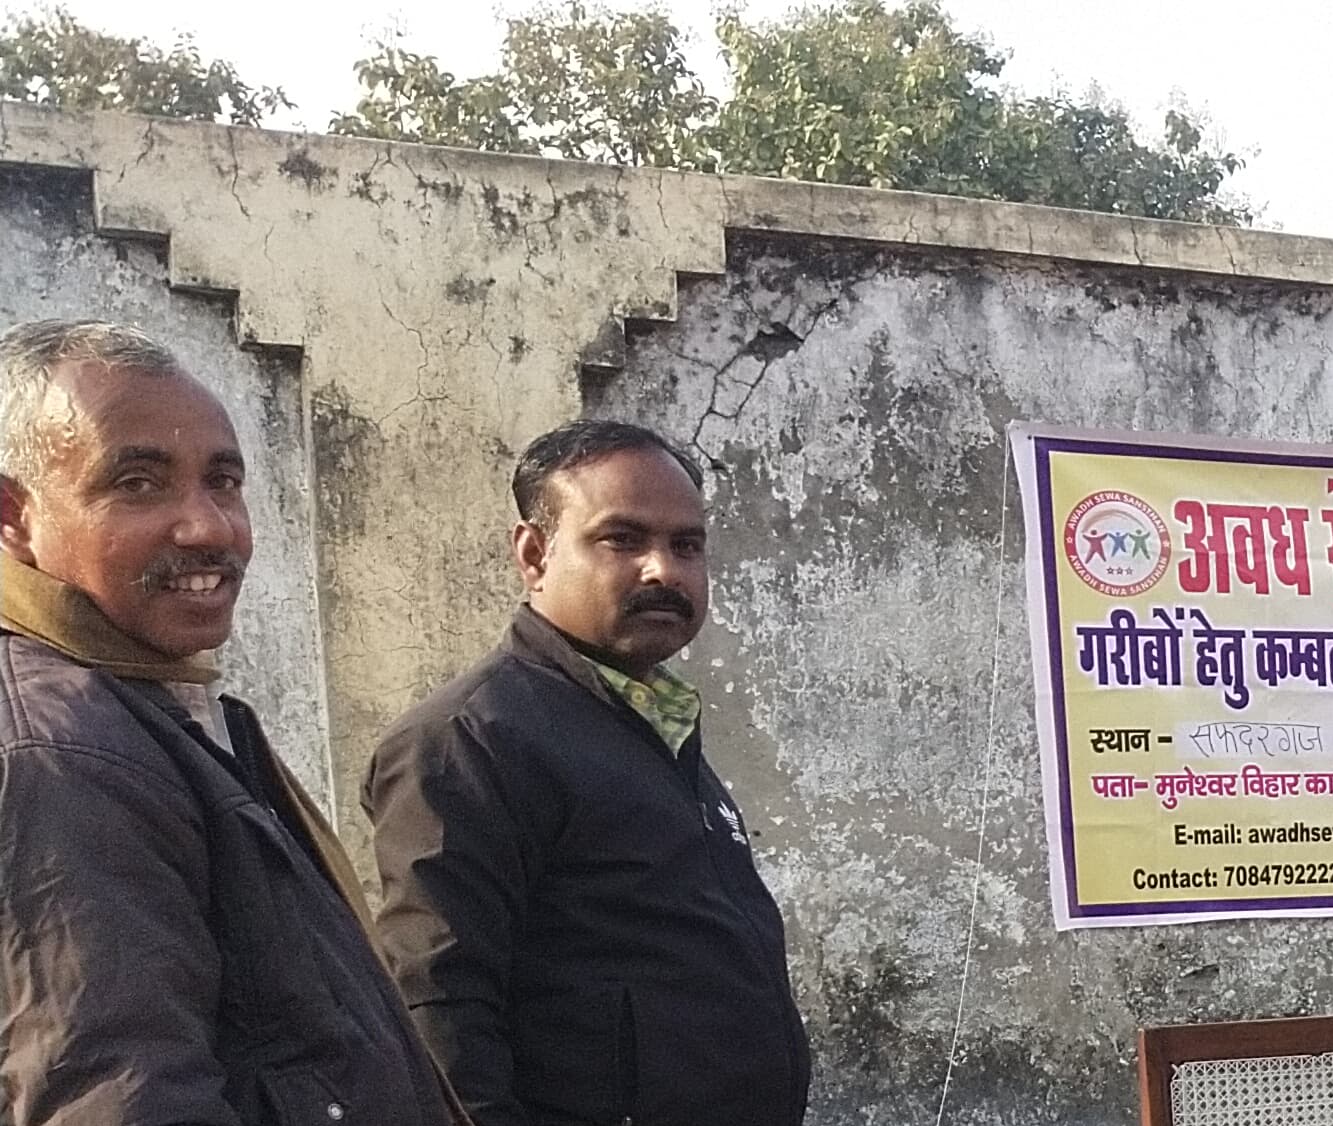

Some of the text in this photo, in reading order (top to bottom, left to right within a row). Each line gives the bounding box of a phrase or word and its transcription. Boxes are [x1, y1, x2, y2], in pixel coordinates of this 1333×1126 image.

[1067, 491, 1166, 533] AWADH SEWA SANSTHAN
[1174, 500, 1311, 595] अवध
[1069, 554, 1168, 596] AWADH SEWA SANSTHAN
[1077, 608, 1183, 686] गरीबों
[1190, 608, 1250, 710] हेतु
[1089, 729, 1151, 753] स्थान
[1155, 766, 1238, 810] मुनेश्वर
[1241, 765, 1300, 798] विहार
[1174, 824, 1242, 846] E-mail:
[1133, 868, 1218, 890] Contact:
